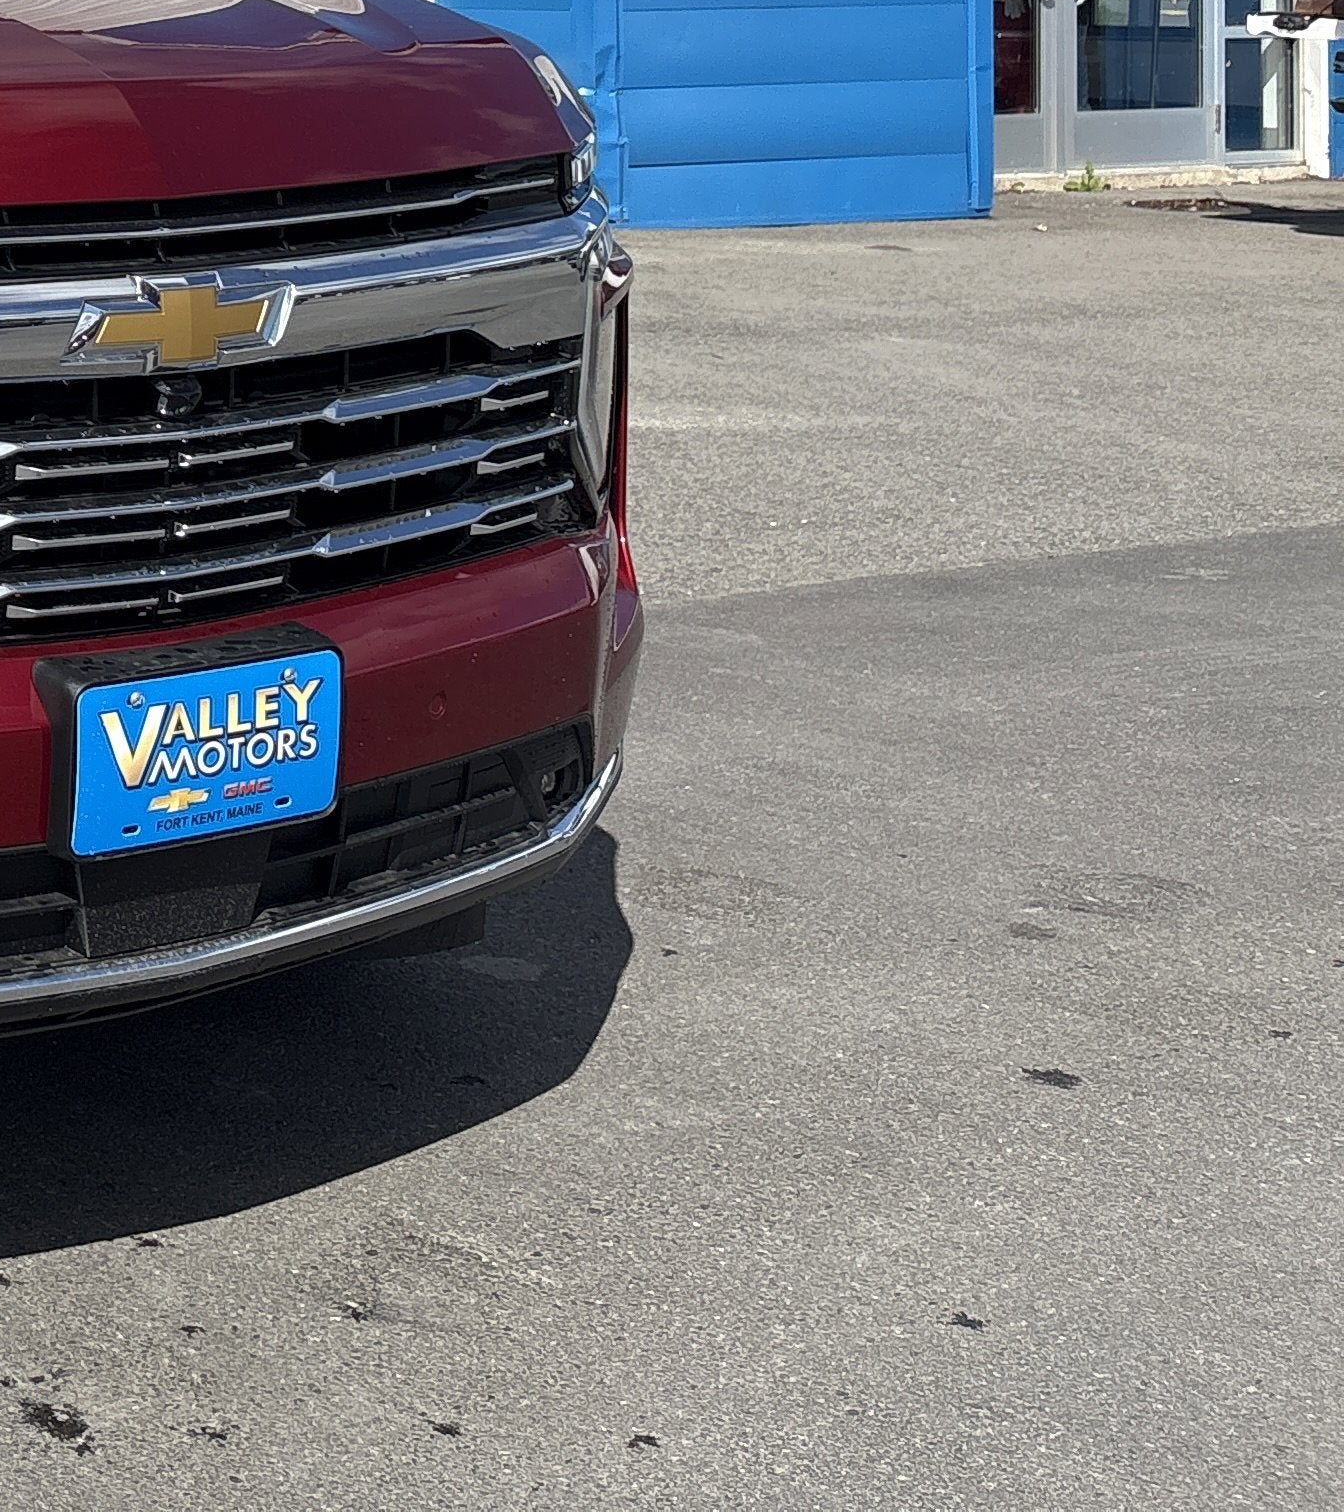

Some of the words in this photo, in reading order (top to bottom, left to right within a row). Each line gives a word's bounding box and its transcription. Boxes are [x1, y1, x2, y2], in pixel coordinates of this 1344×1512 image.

[99, 678, 323, 789] VALLEY
[147, 723, 320, 785] MOTORS
[223, 776, 272, 800] GMC
[156, 816, 189, 832] FORT
[191, 809, 224, 825] KENT,
[226, 802, 264, 820] MAINE
